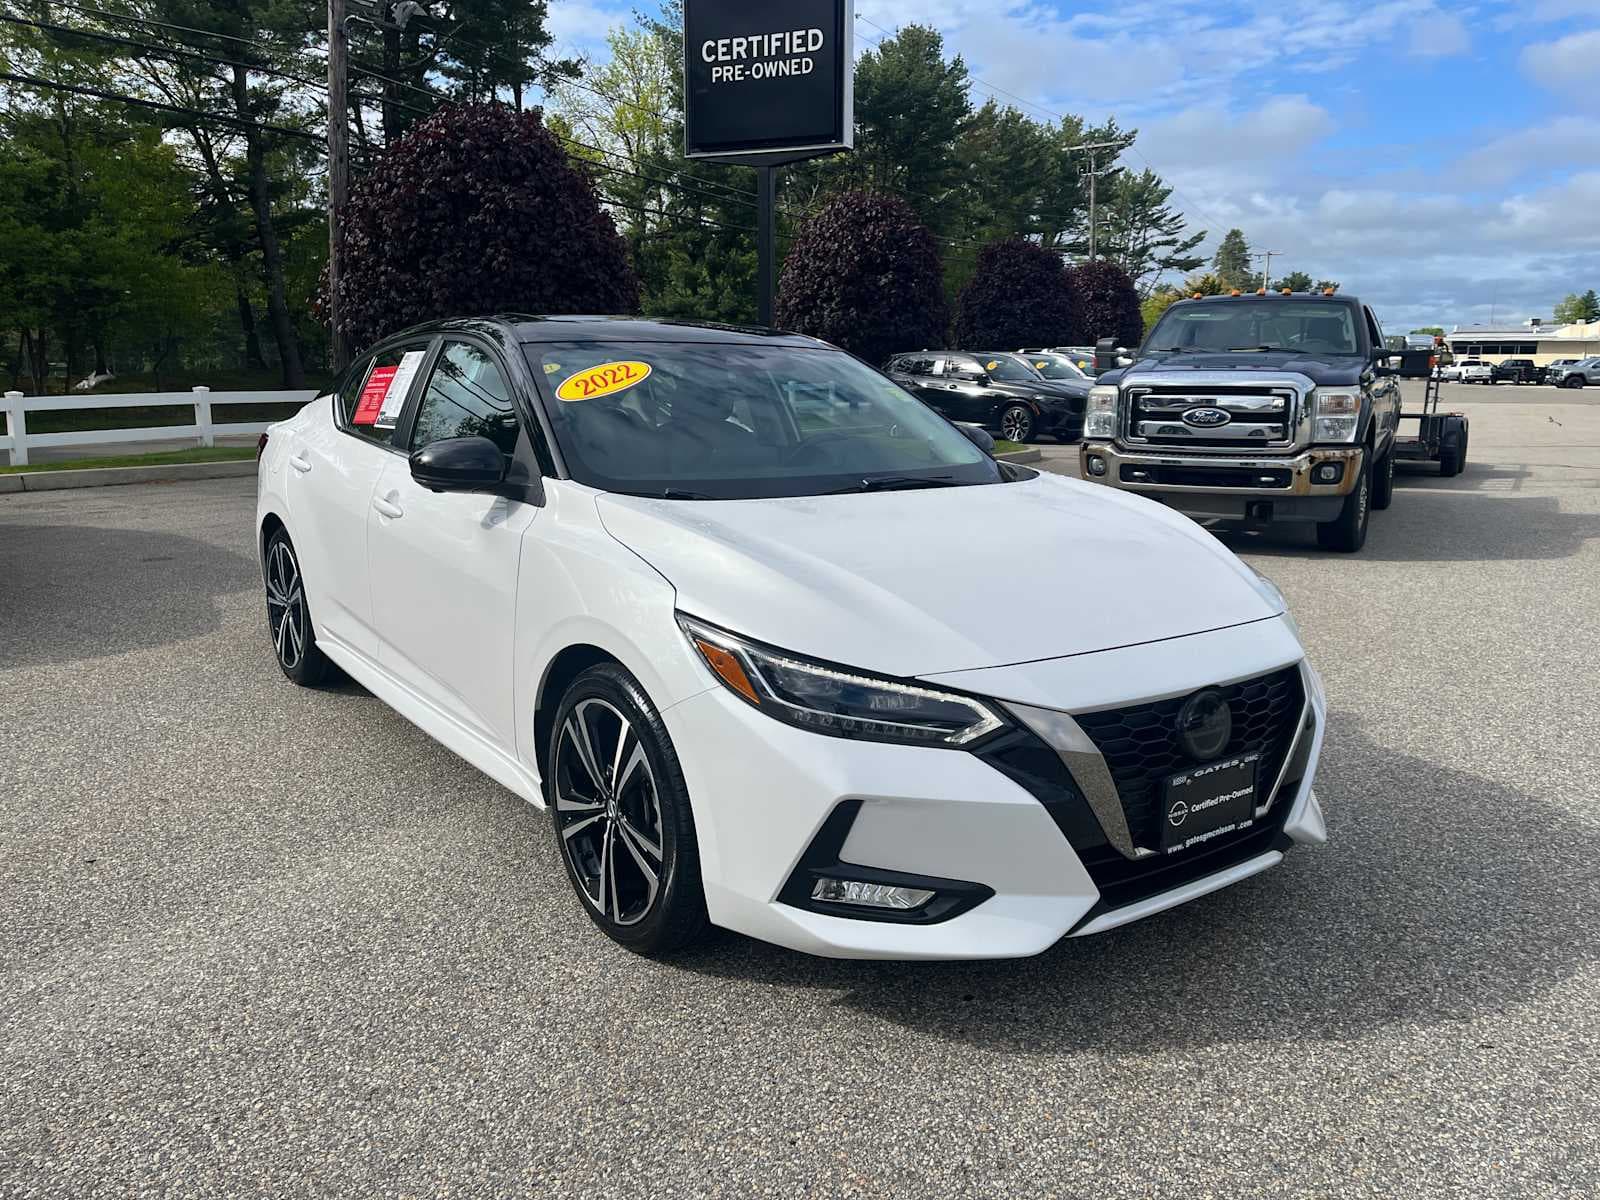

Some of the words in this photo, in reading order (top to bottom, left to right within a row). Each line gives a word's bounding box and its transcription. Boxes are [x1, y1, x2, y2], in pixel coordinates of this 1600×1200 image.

[701, 28, 824, 63] CERTIFIED
[711, 57, 814, 83] PRE-OWNED
[575, 364, 638, 396] 2022
[1192, 410, 1220, 422] Ford
[1194, 759, 1240, 777] GATES
[1191, 797, 1219, 812] Certified
[1219, 785, 1254, 803] Pre-Owned
